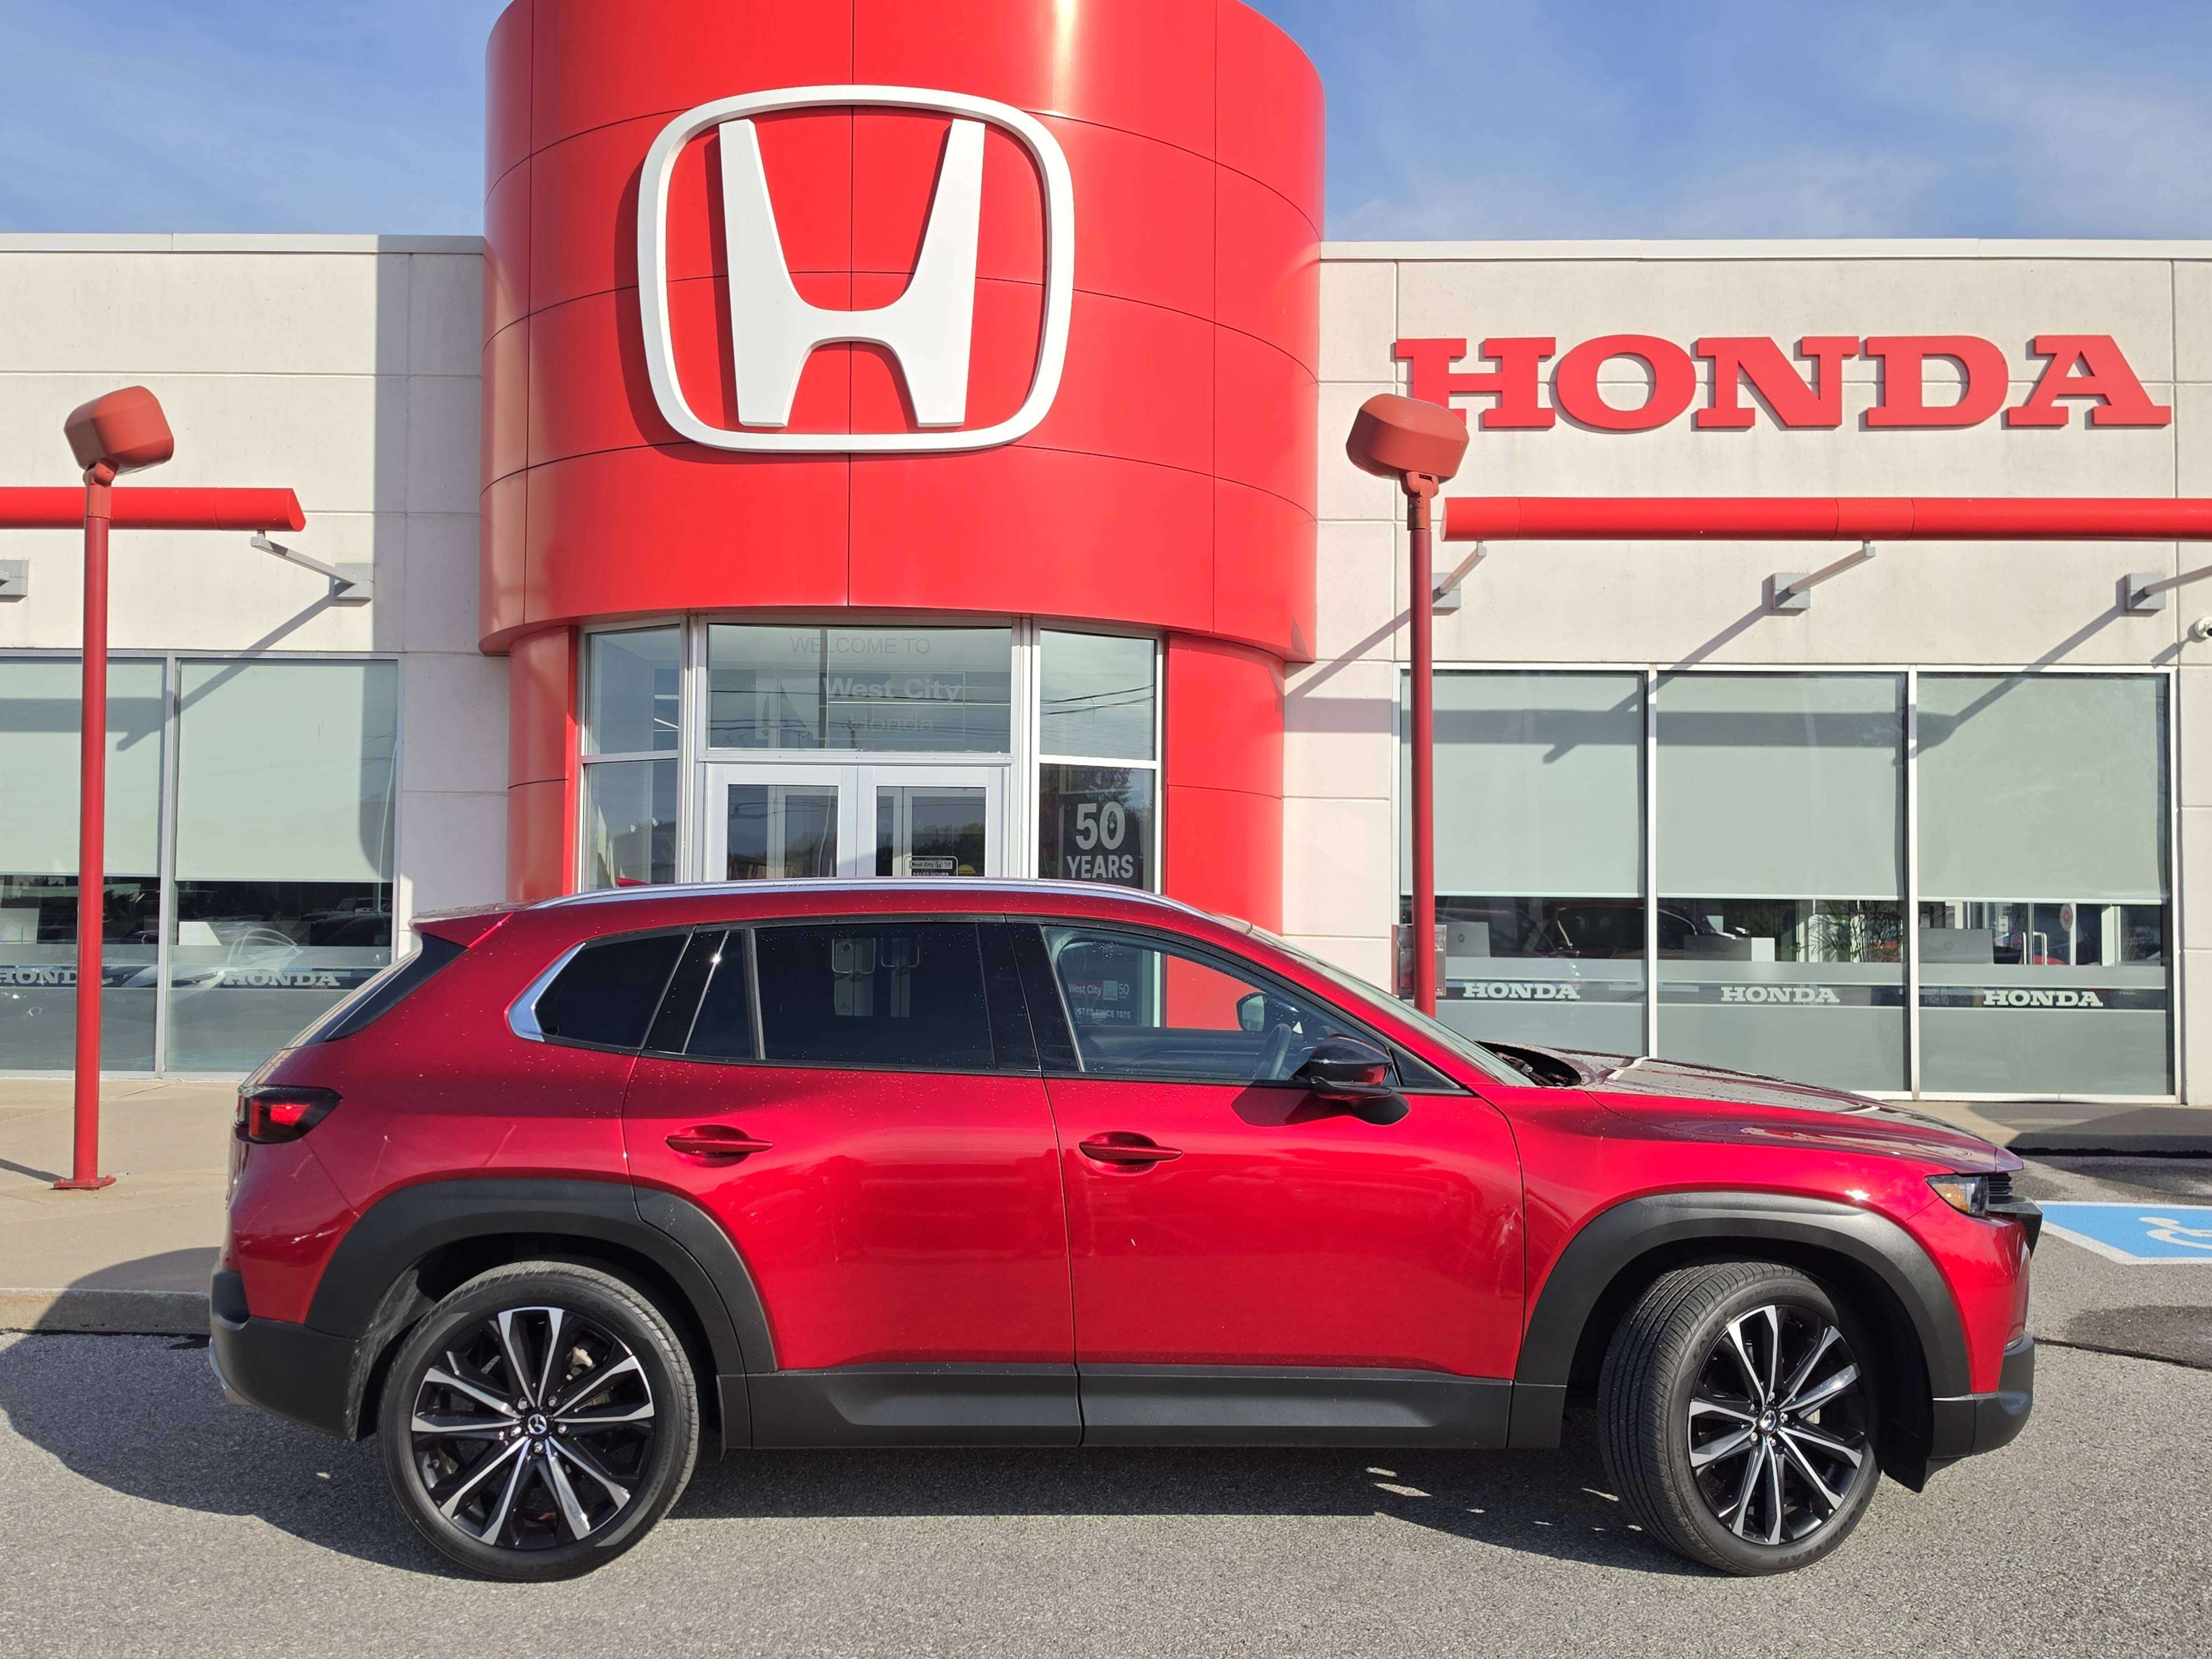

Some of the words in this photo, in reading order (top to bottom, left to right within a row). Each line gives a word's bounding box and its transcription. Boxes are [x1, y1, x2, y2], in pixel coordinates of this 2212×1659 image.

[1394, 334, 2172, 430] HONDA
[790, 637, 897, 653] WELCOME
[903, 638, 930, 654] TO
[823, 677, 893, 699] West
[904, 678, 962, 703] City
[1075, 801, 1126, 850] 50
[1066, 854, 1133, 879] YEARS
[223, 970, 340, 986] HONDA
[1068, 983, 1085, 994] West
[1087, 983, 1102, 997] City
[1118, 983, 1129, 995] 50
[1463, 982, 1580, 1000] HONDA
[1721, 986, 1840, 1003] HONDA
[1983, 989, 2103, 1007] HONDA
[1116, 1010, 1131, 1019] 1975
